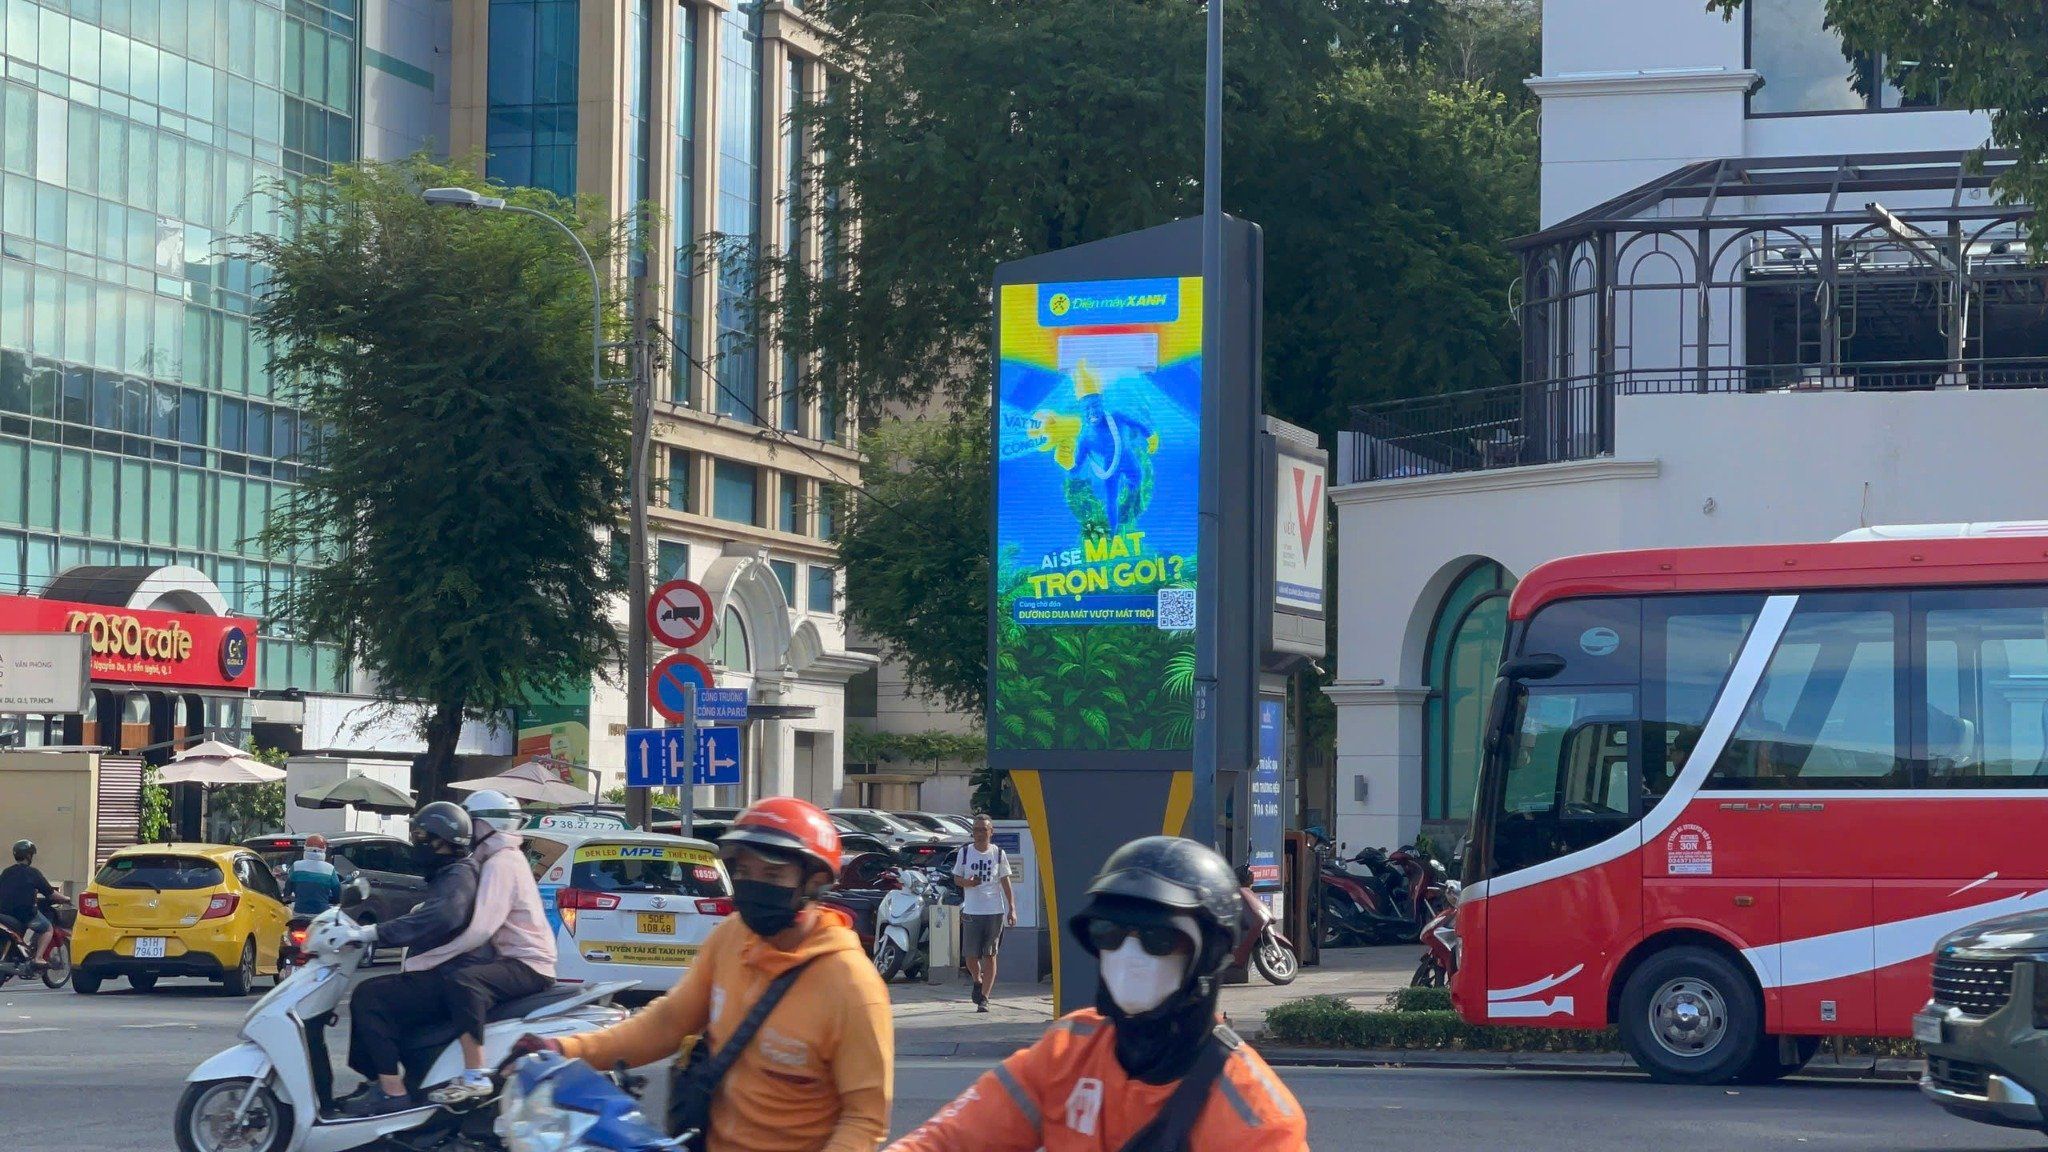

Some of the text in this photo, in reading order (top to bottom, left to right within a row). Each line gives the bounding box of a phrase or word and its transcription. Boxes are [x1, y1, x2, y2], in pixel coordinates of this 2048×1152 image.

[1027, 567, 1109, 602] TRỌN
[1052, 610, 1070, 619] ĐUA
[1070, 608, 1088, 619] MÁT
[1089, 608, 1114, 620] VƯỢT
[701, 691, 718, 701] CÔNG
[697, 705, 716, 717] CÔNG
[727, 707, 747, 717] PARIS
[1680, 842, 1698, 850] 30N
[620, 847, 665, 857] MPE
[648, 914, 665, 923] 50E
[142, 938, 159, 946] 51H
[136, 947, 163, 957] 794.01
[659, 947, 675, 955] TAXI
